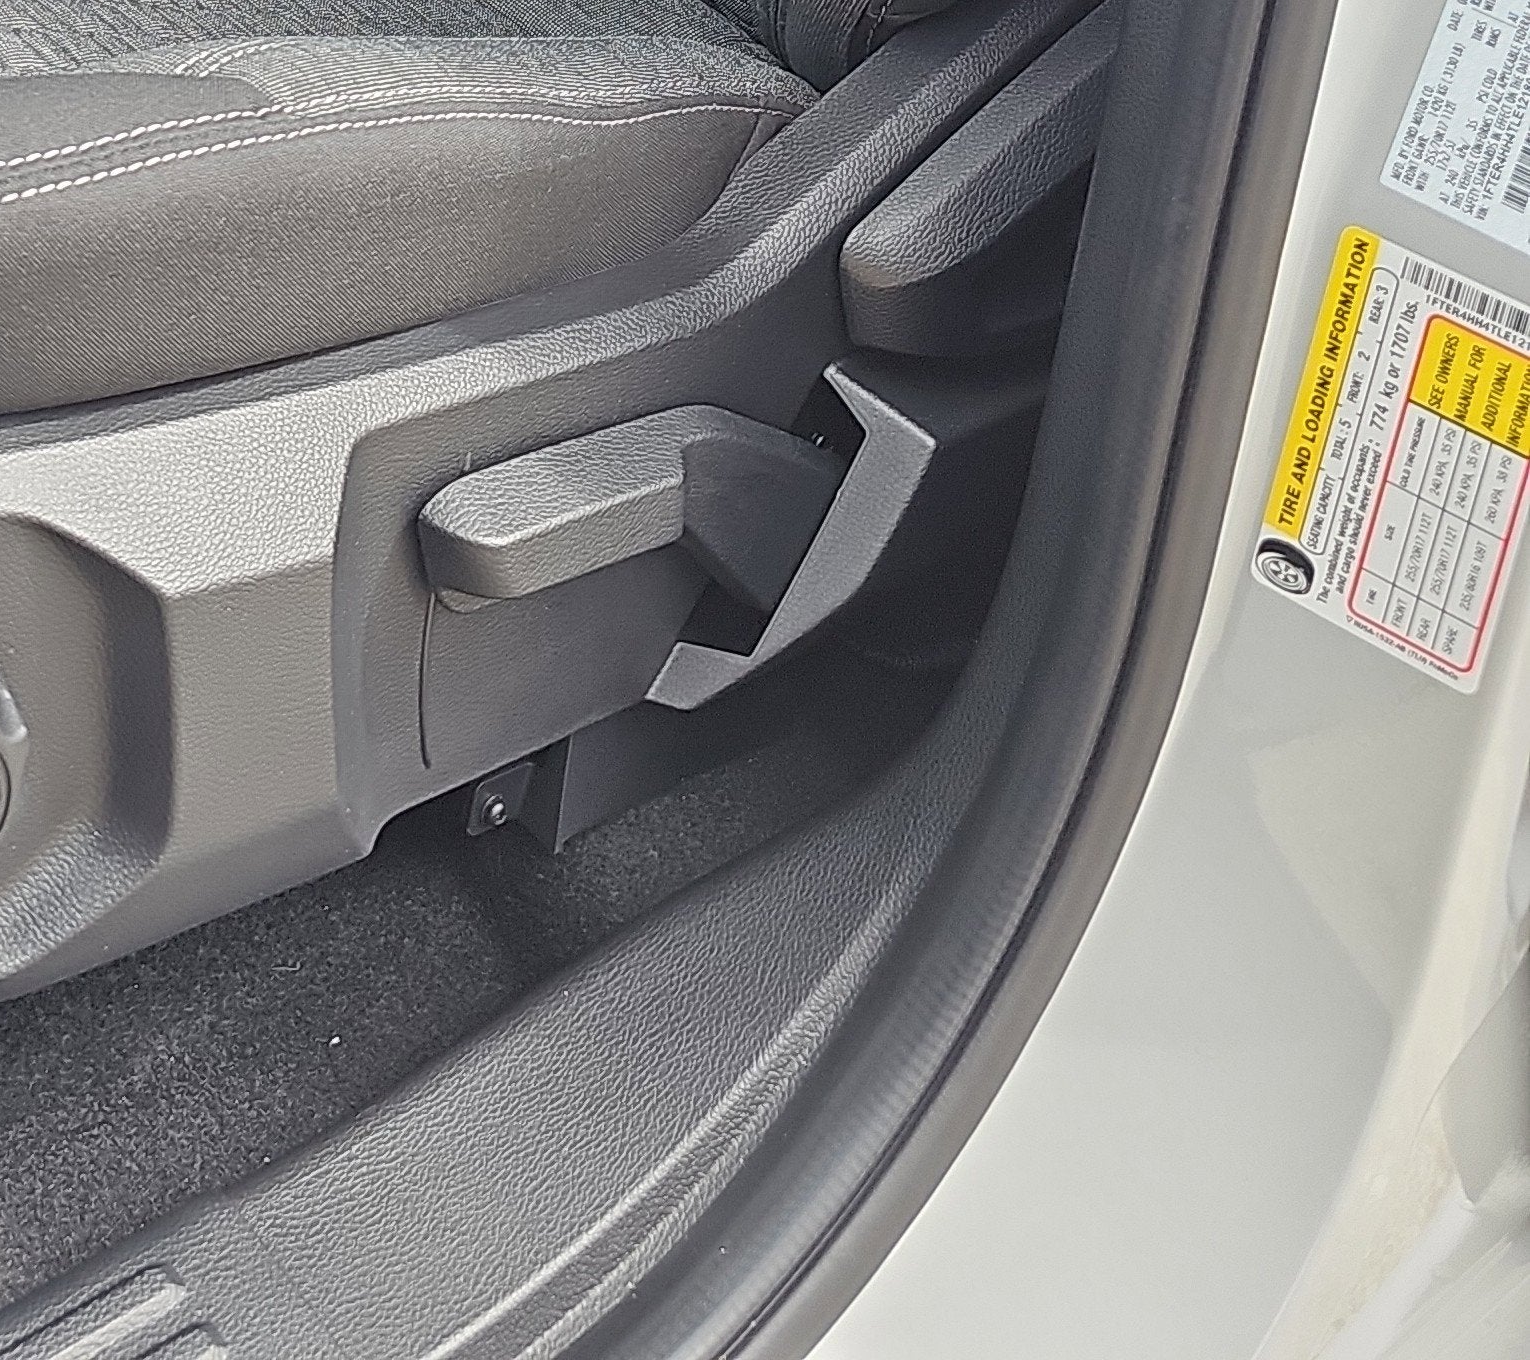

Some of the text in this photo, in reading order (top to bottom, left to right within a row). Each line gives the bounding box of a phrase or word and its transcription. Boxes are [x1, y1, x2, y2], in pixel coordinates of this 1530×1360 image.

[1375, 284, 1389, 296] 3
[1357, 350, 1370, 362] 2
[1389, 323, 1410, 359] 1707
[1278, 238, 1368, 525] TIRE AND LOADING INFORMATION
[1387, 361, 1401, 379] or
[1427, 333, 1459, 410] SEE OWNERS
[1453, 344, 1486, 422] MANUAL FOR
[1378, 380, 1399, 400] kg
[1481, 362, 1512, 431] ADDITIONAL
[1338, 417, 1352, 429] 5
[1368, 402, 1389, 431] 774
[1399, 468, 1411, 488] COLD
[1409, 417, 1426, 452] PRESSURE
[1428, 427, 1457, 496] 240 35 PSI
[1454, 439, 1482, 509] 240 35 PSI
[1306, 474, 1335, 550] SEATING CAPACITY
[1357, 485, 1371, 513] never
[1348, 512, 1364, 546] should
[1384, 524, 1396, 541] SIZE
[1315, 585, 1331, 604] The
[1324, 537, 1344, 585] combined
[1337, 504, 1353, 538] weight
[1345, 491, 1356, 505] of
[1340, 546, 1356, 574] cargo
[1404, 511, 1432, 583] 255/70R17 112T
[1335, 573, 1347, 594] and
[1390, 597, 1407, 628] FRONT
[1415, 617, 1431, 642] REAR
[1441, 626, 1458, 655] SPARE
